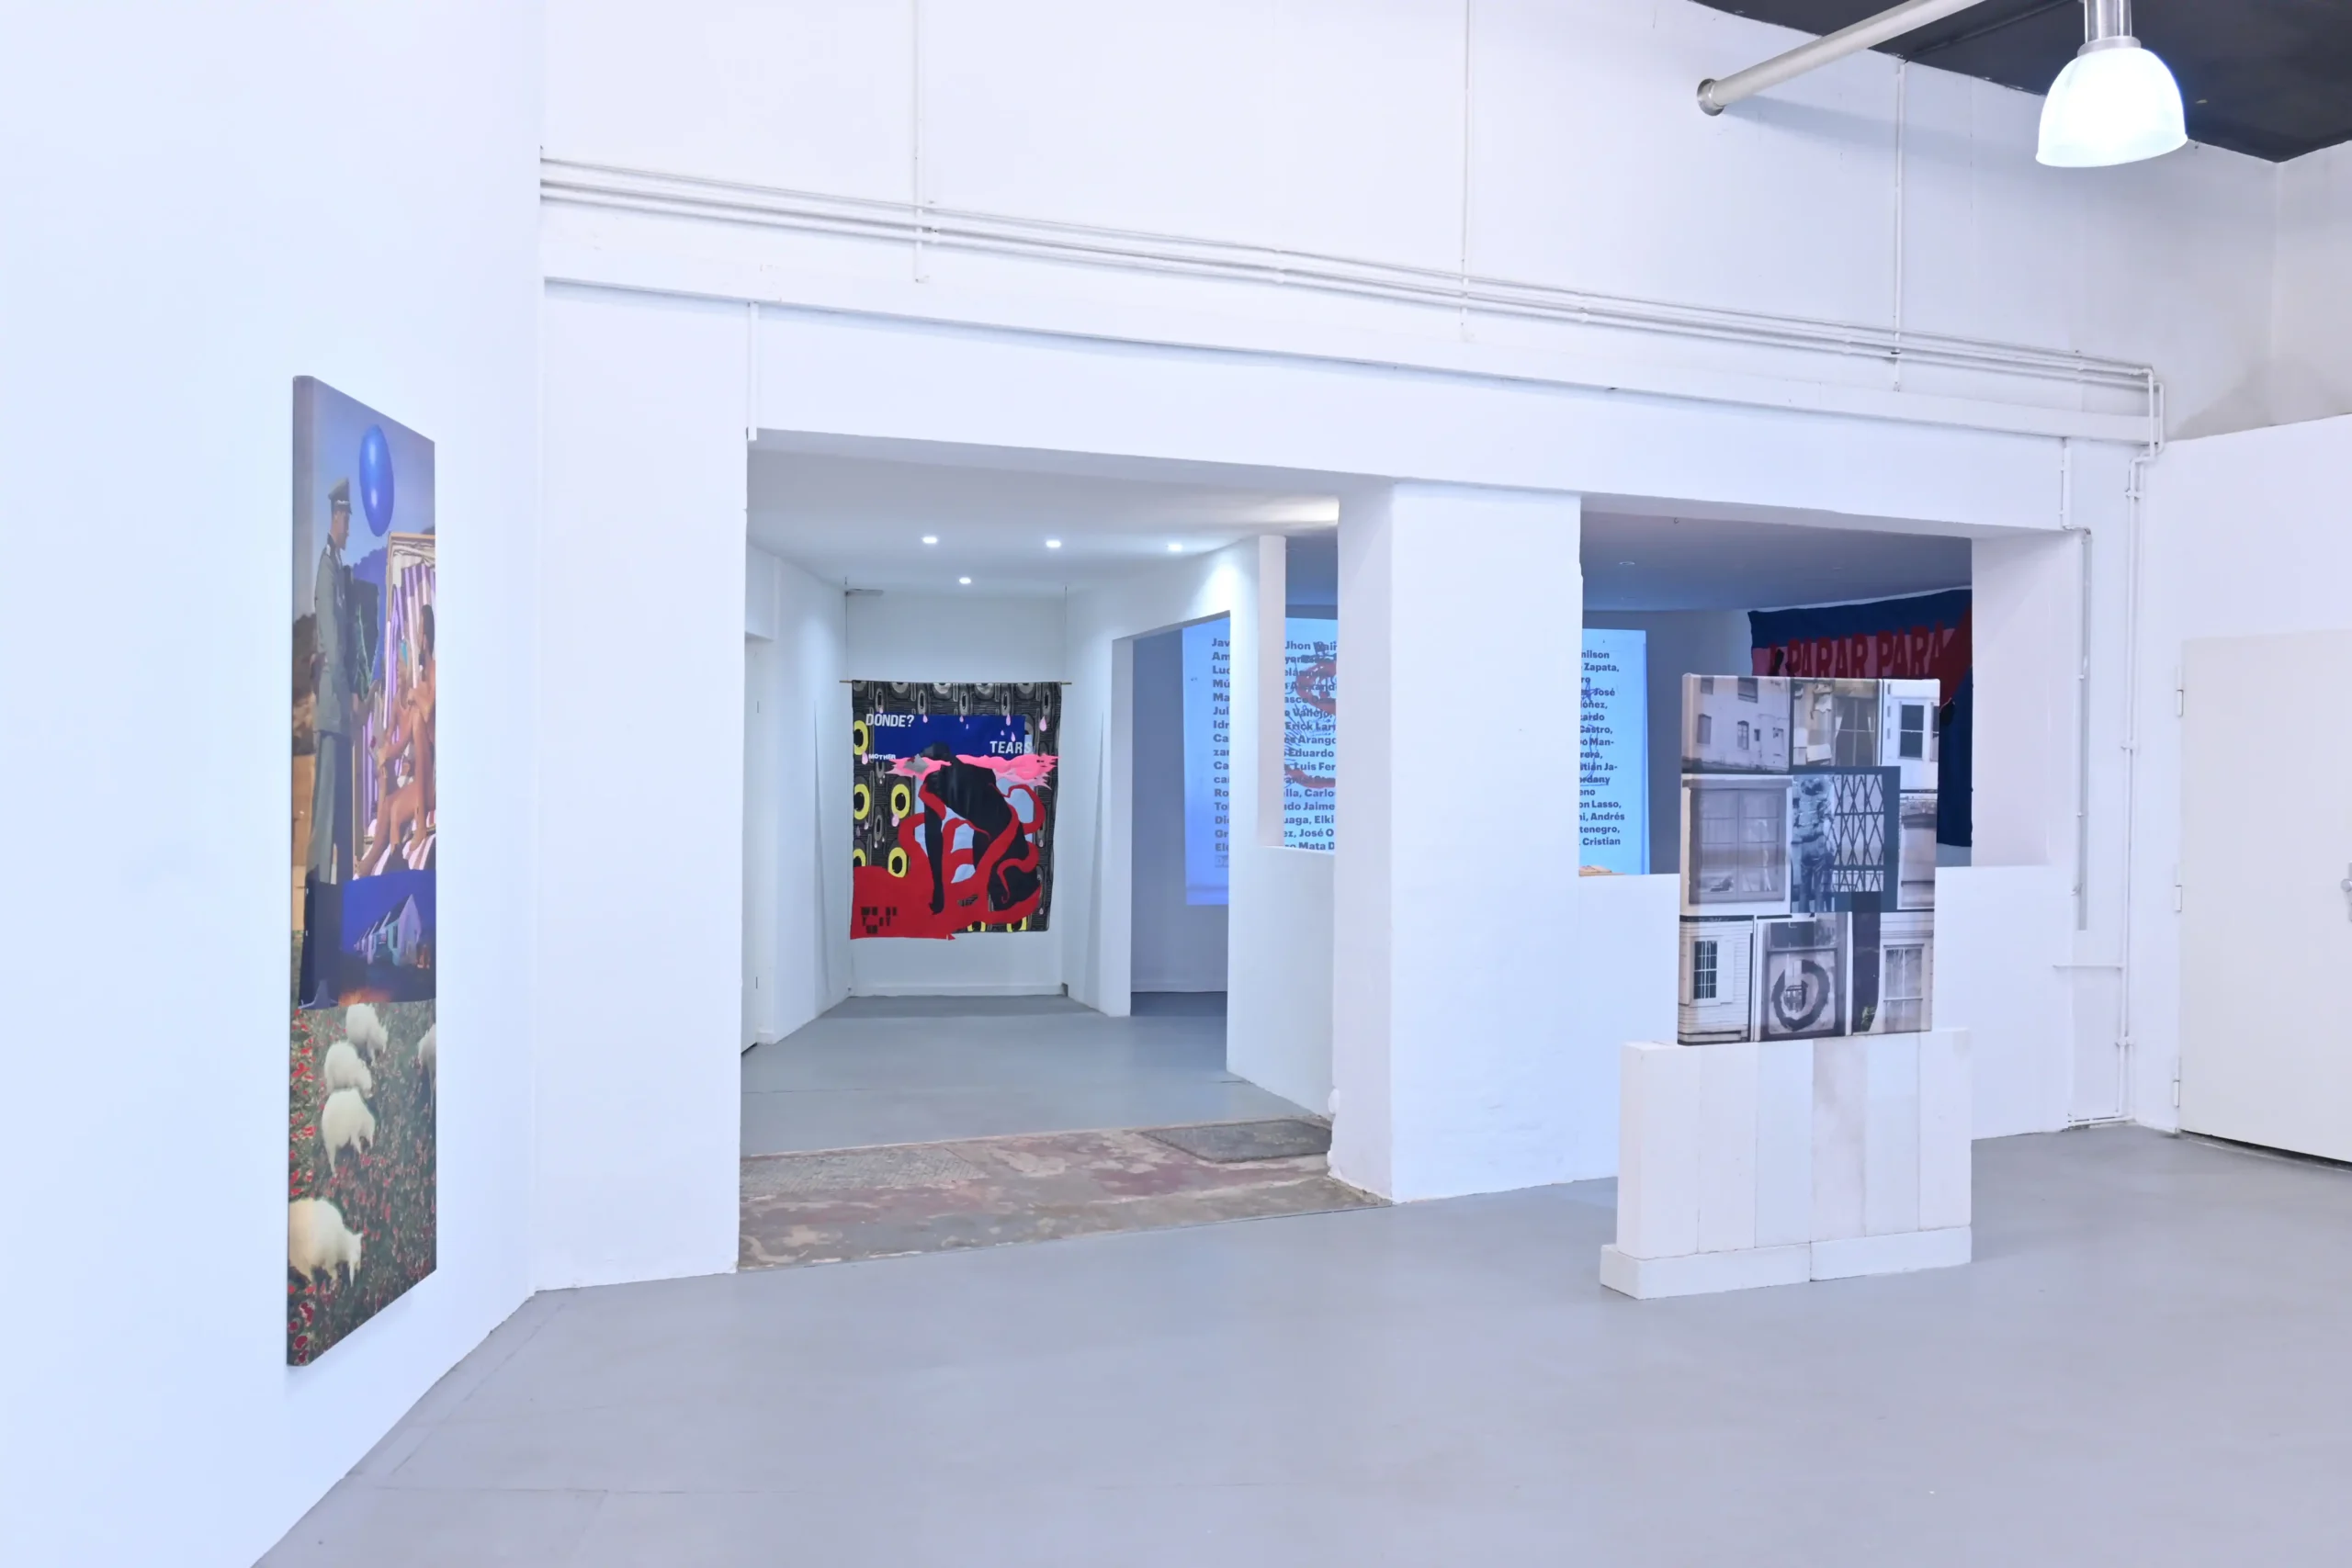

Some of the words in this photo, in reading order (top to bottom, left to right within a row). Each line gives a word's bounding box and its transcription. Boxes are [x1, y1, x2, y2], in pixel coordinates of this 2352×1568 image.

[1584, 663, 1620, 672] Zapata,
[989, 740, 1033, 754] TEARS
[1289, 749, 1334, 757] Eduardo
[1591, 800, 1622, 809] Lasso,
[1590, 812, 1625, 820] Andrés
[1299, 829, 1324, 837] José
[1582, 837, 1621, 846] Cristian
